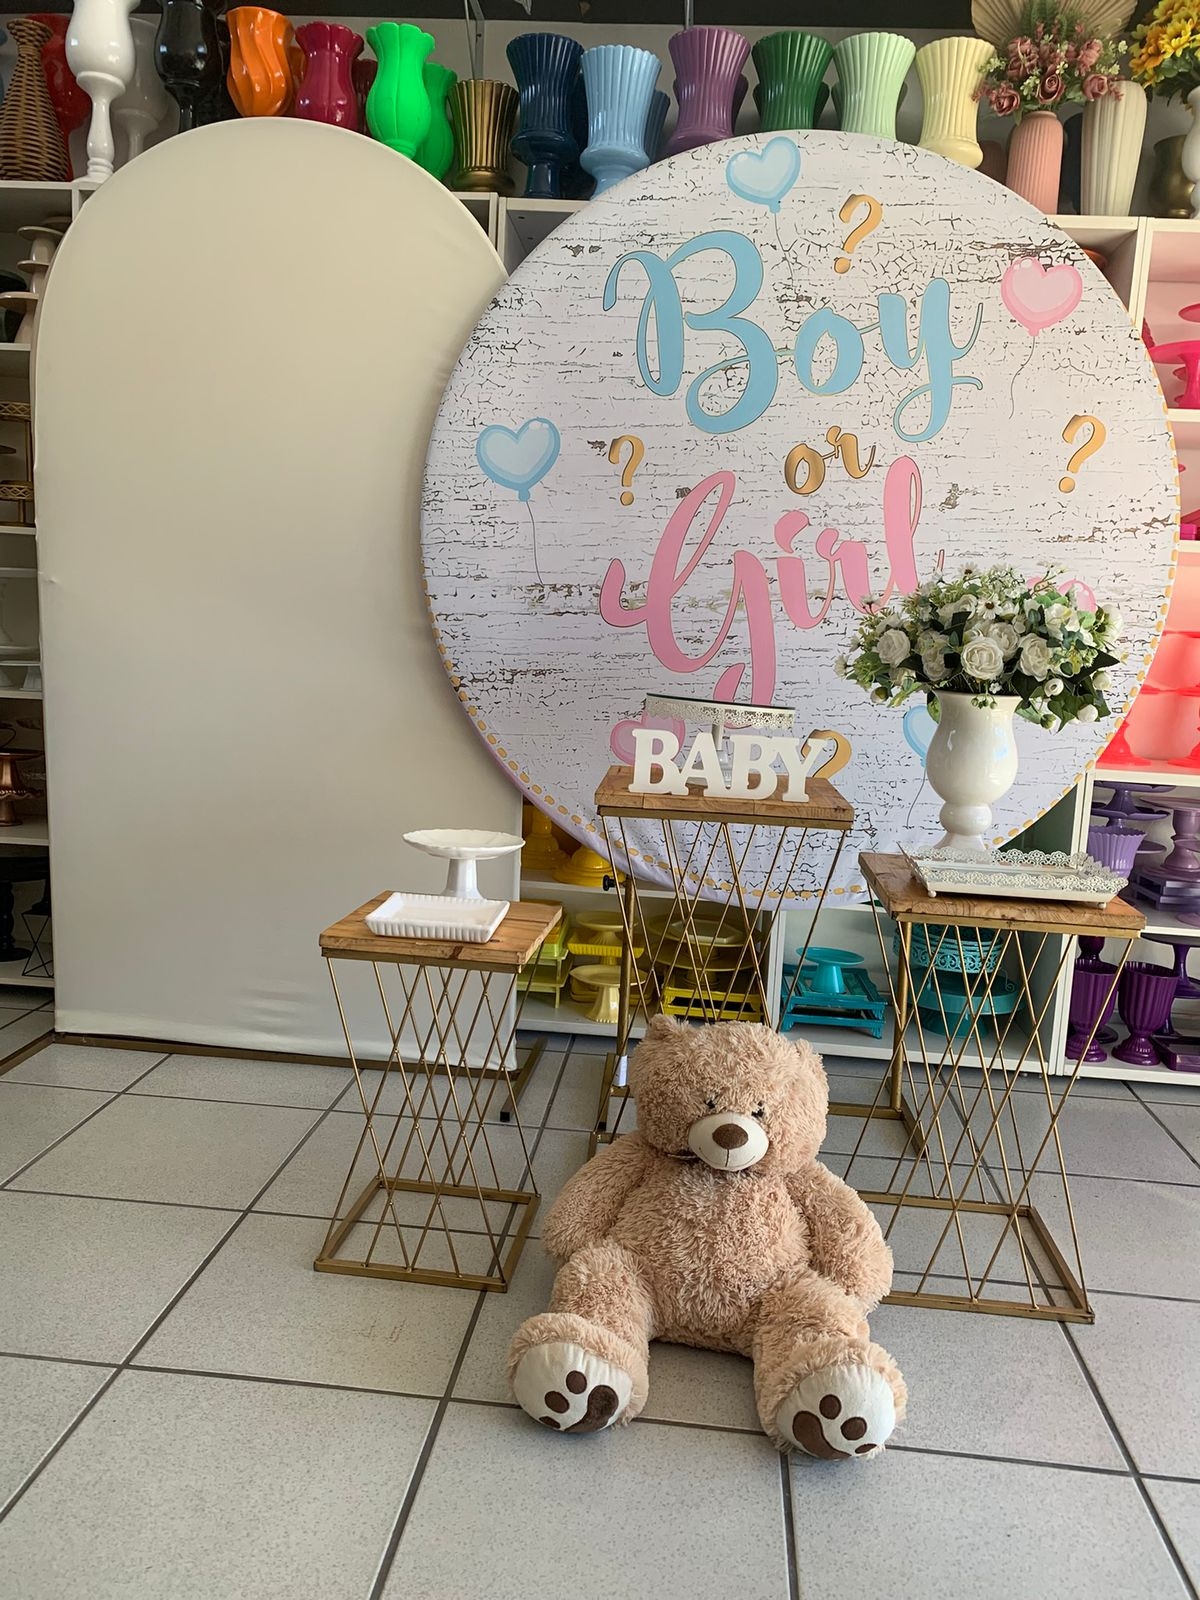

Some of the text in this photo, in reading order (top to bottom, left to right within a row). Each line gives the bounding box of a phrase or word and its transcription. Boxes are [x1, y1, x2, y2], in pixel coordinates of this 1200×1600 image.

[603, 230, 983, 442] Boy
[784, 425, 876, 495] or
[599, 455, 945, 729] Girl
[628, 728, 828, 802] BABY
